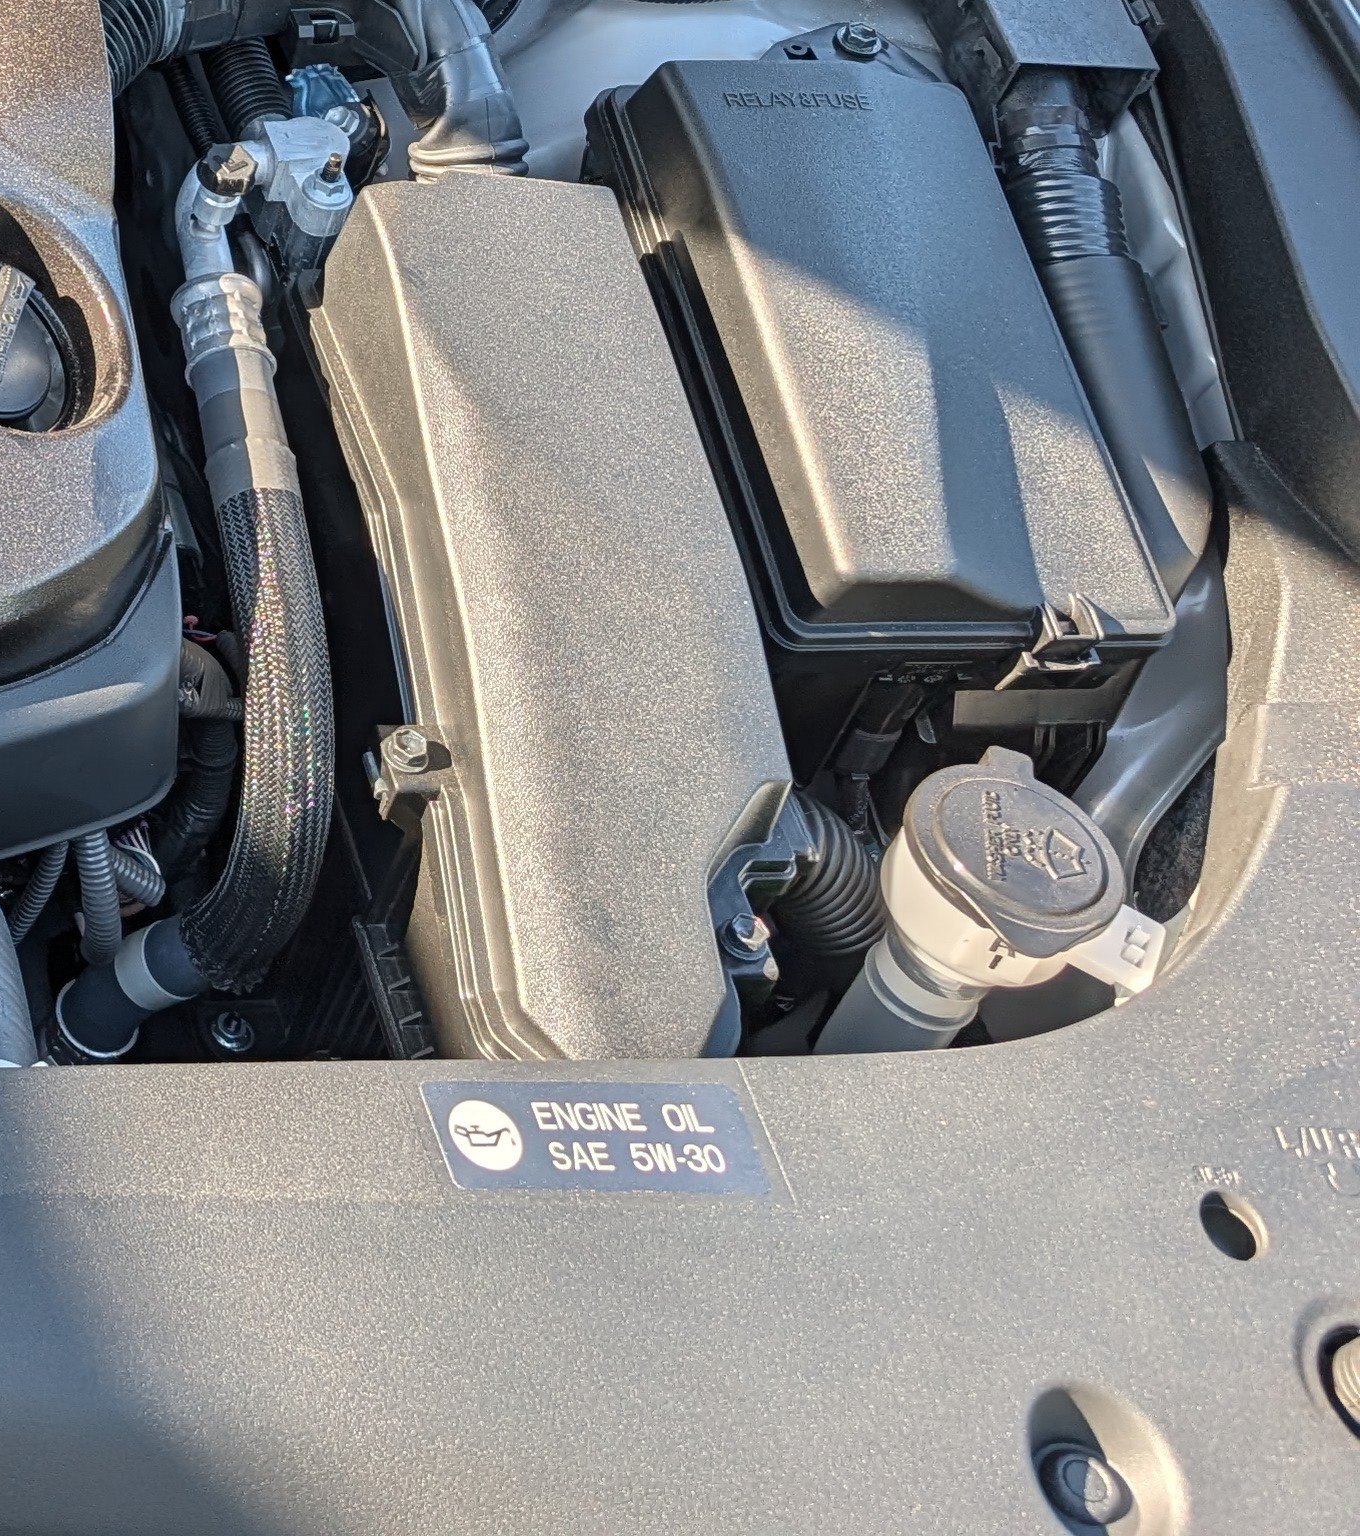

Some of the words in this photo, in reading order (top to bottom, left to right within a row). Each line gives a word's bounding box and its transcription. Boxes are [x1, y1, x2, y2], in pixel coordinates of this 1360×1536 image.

[531, 1102, 648, 1132] ENGINE
[661, 1103, 715, 1133] OIL
[548, 1141, 616, 1171] SAE
[630, 1142, 727, 1174] 5W-30
